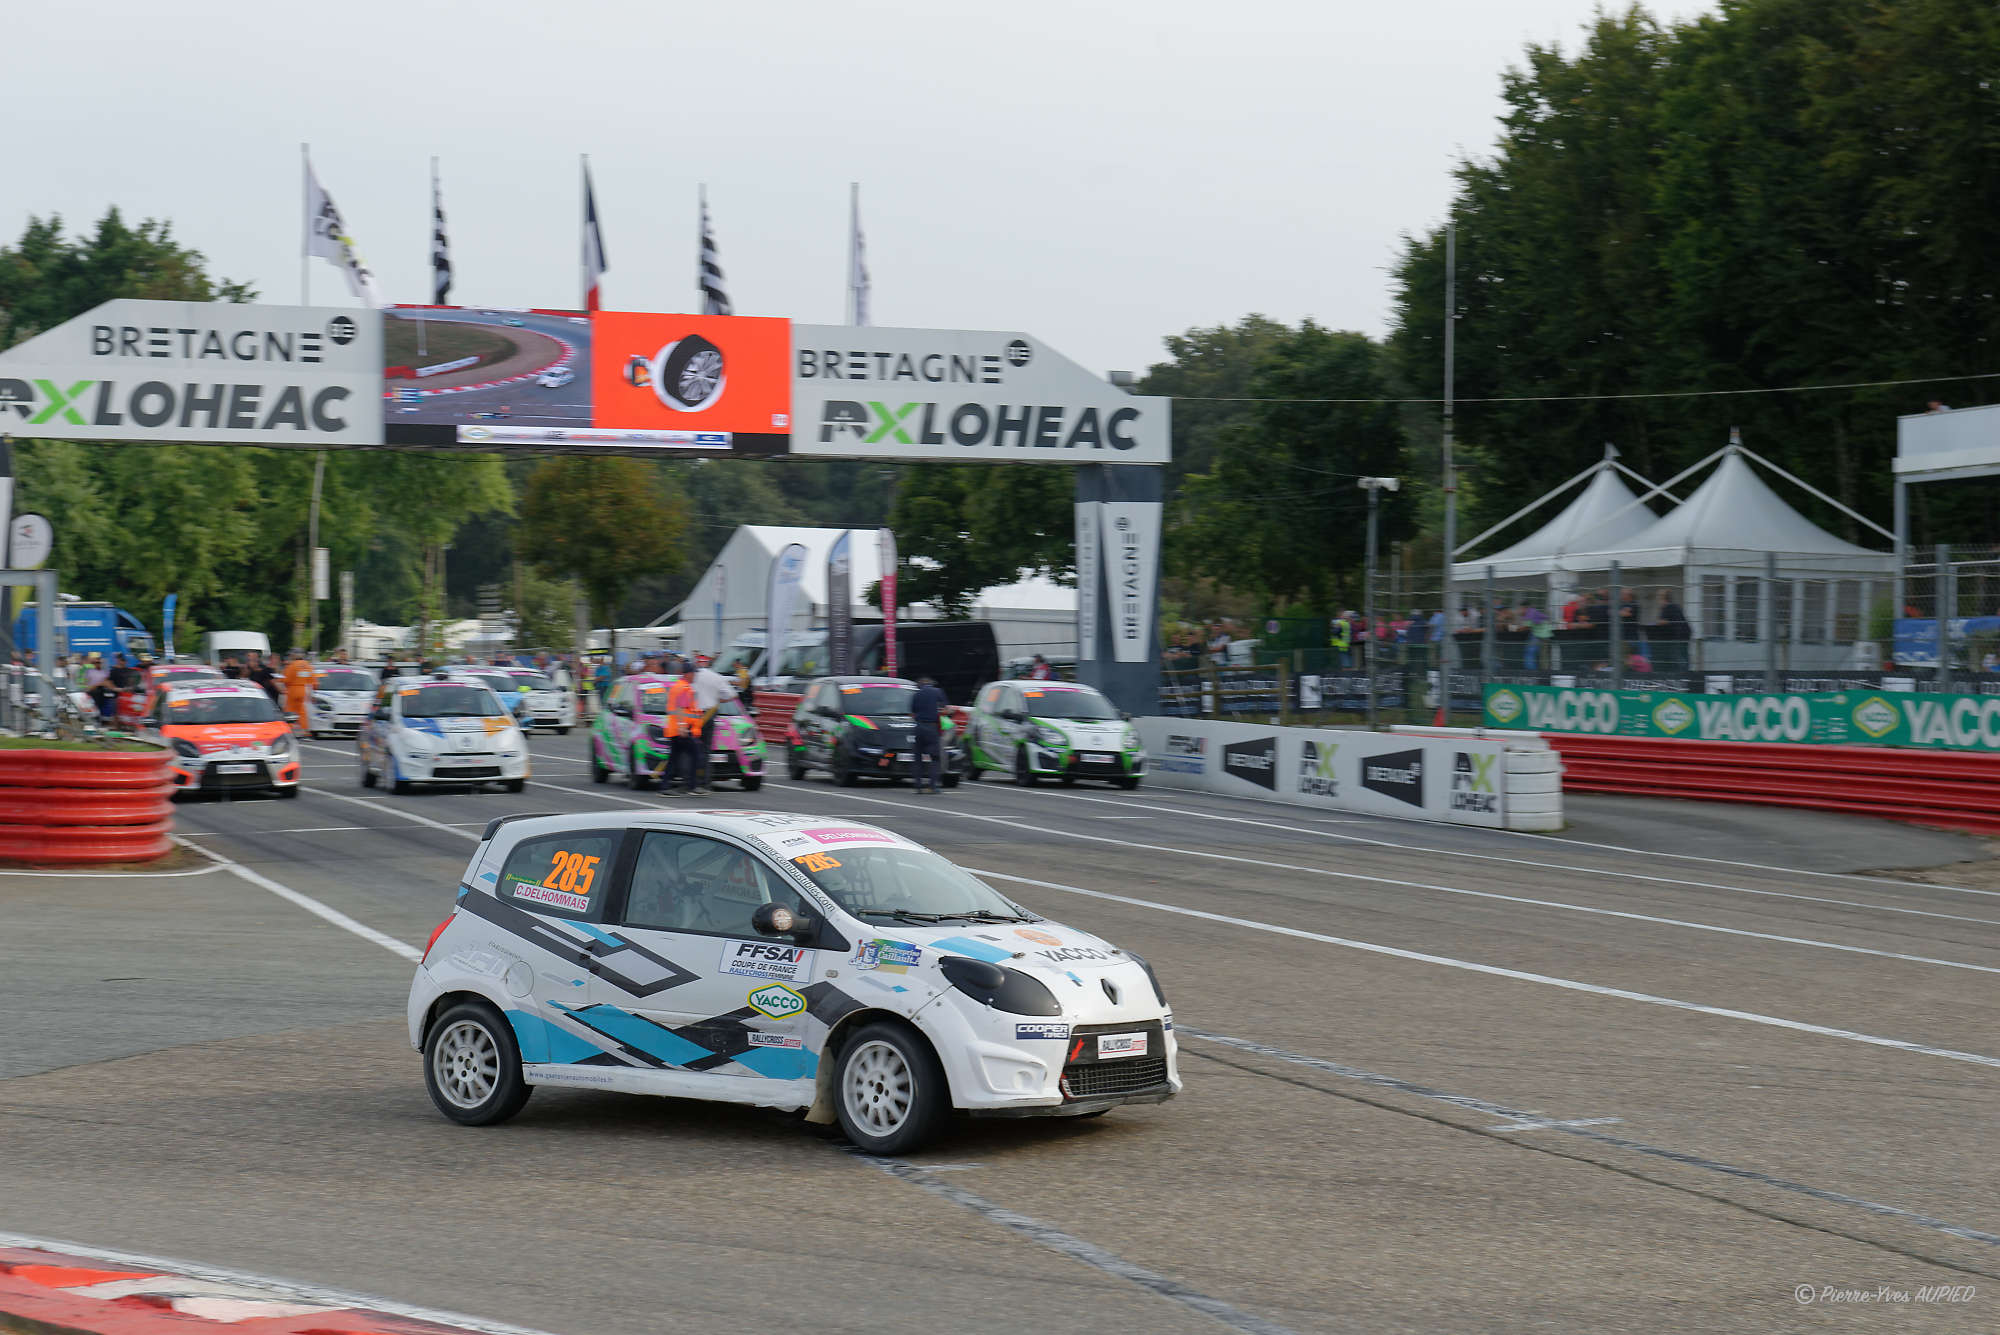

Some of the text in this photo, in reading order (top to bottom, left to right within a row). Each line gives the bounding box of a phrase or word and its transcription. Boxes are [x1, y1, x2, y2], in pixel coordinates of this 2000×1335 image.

[93, 325, 324, 363] BRETAGNE
[799, 349, 1003, 384] BRETAGNE
[1122, 532, 1140, 640] BRETAGNE
[1523, 690, 1619, 734] YACCO
[1696, 696, 1810, 742] YACCO
[542, 850, 601, 895] 285
[795, 852, 842, 873] 285
[516, 885, 587, 910] C.DELHOMMAIS
[736, 944, 794, 963] FFSA
[1034, 948, 1108, 962] YACCO
[731, 960, 797, 974] COUPE DE FRANCE
[755, 993, 799, 1009] YACCO
[752, 1034, 784, 1044] RALLYCROSS
[1017, 1024, 1068, 1033] COOPER
